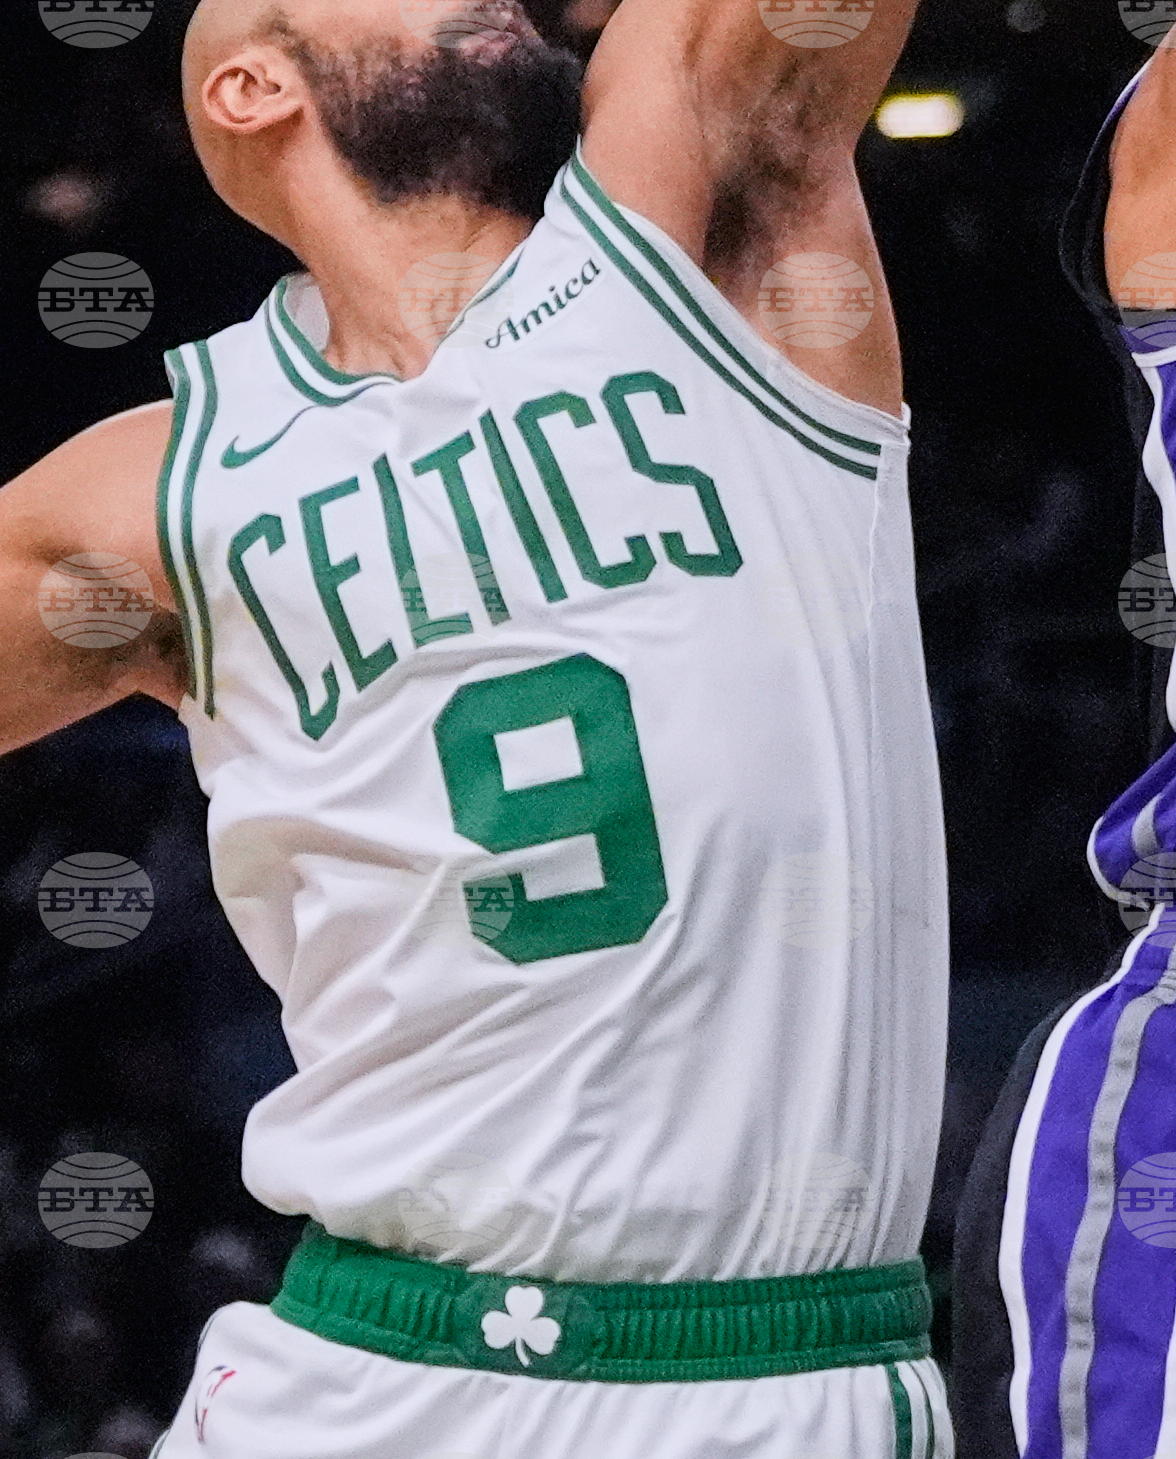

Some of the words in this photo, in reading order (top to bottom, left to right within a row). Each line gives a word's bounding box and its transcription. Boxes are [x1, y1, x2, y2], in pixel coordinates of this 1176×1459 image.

[484, 257, 601, 349] Amica
[227, 370, 744, 742] CELTICS
[432, 652, 669, 967] 9
